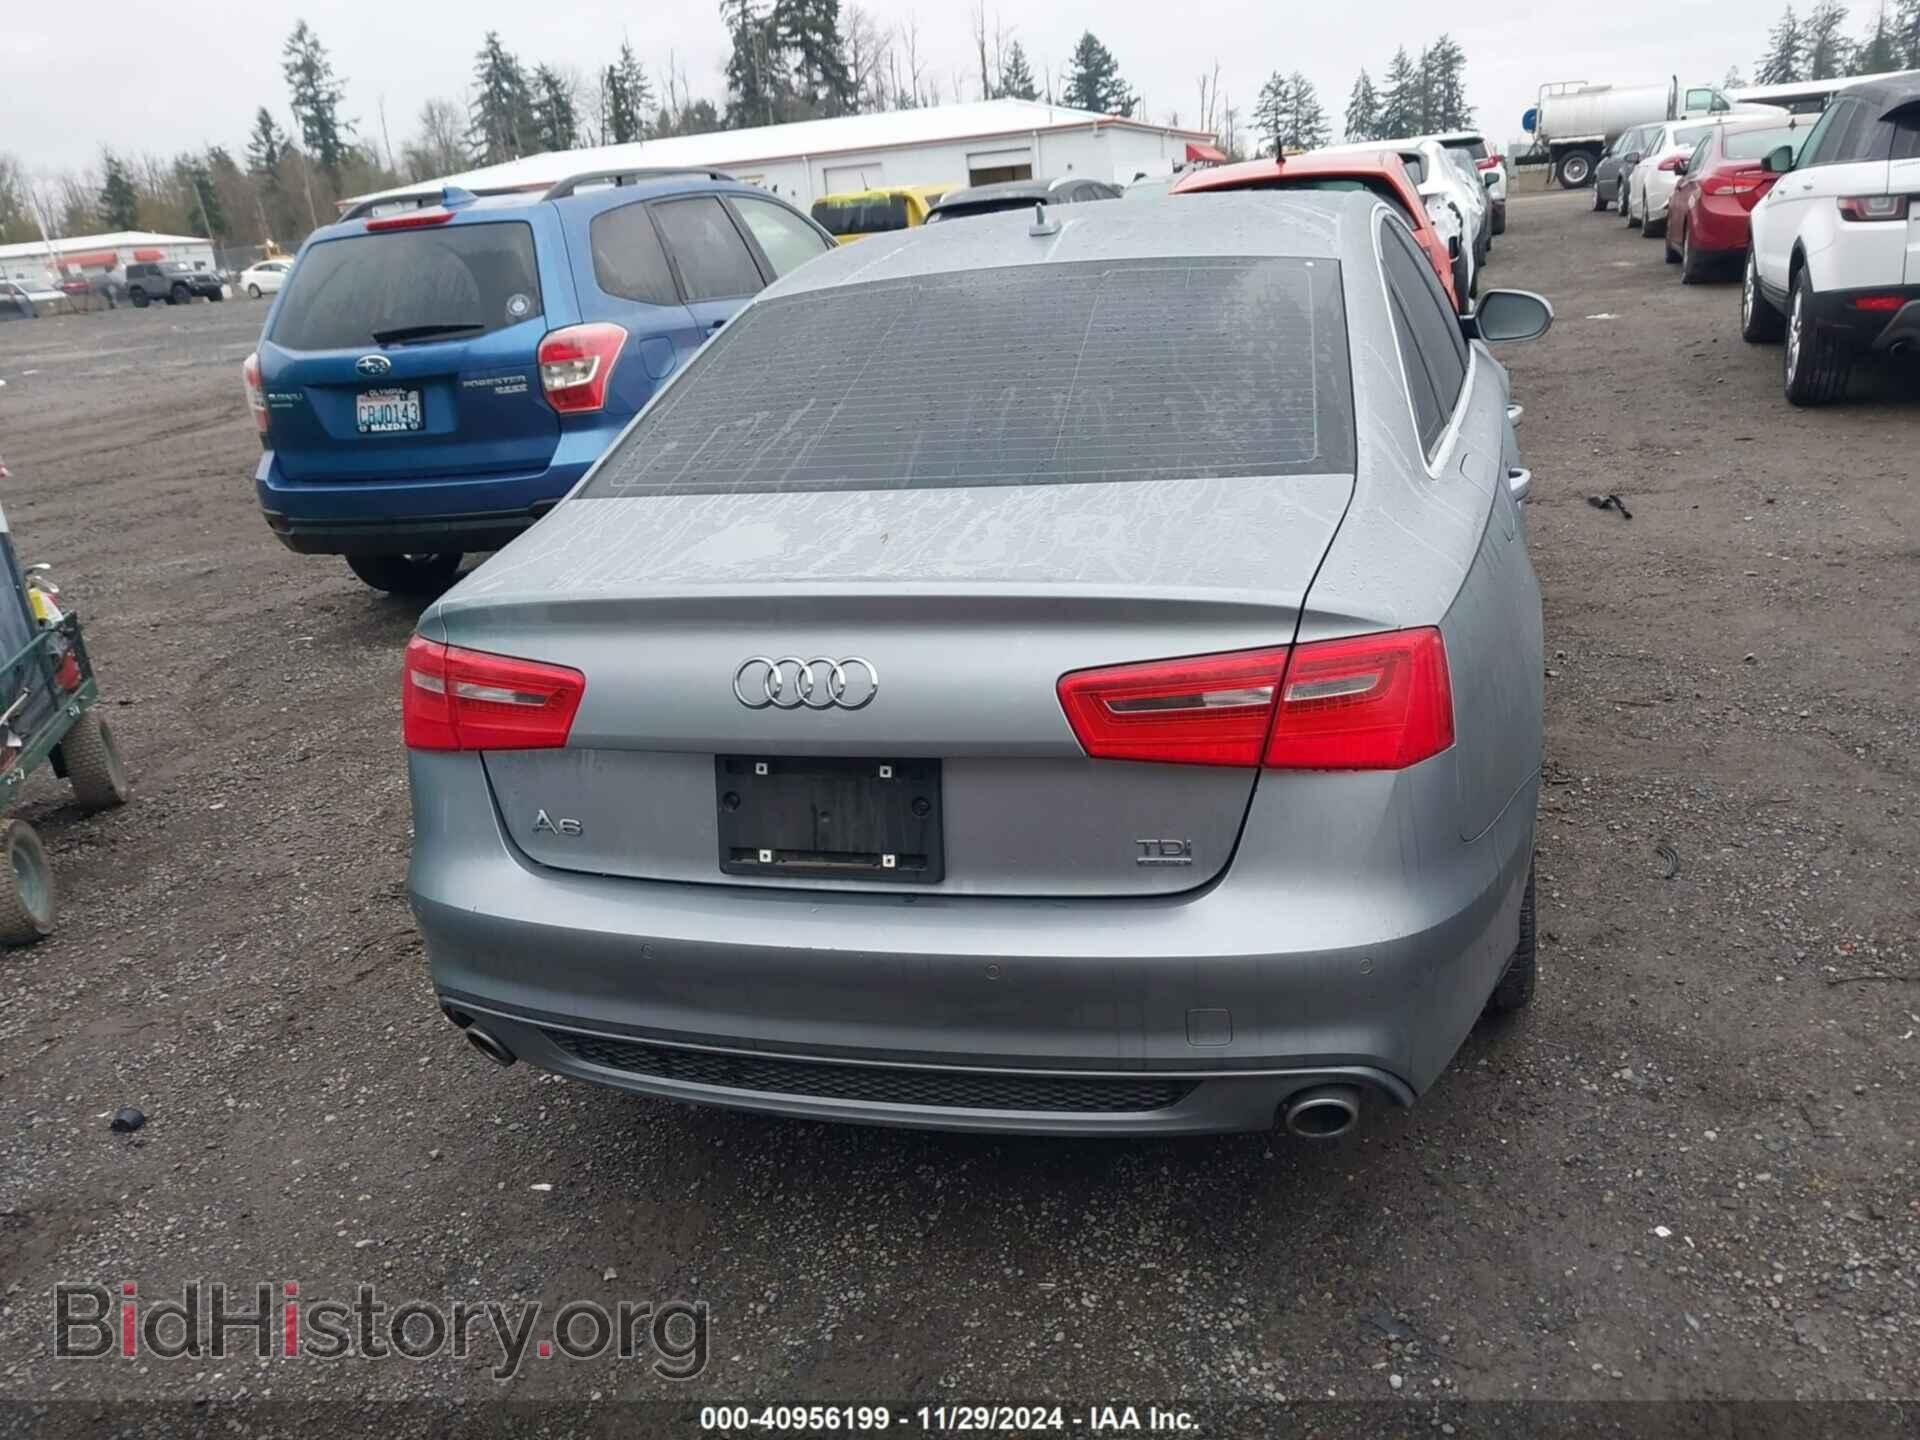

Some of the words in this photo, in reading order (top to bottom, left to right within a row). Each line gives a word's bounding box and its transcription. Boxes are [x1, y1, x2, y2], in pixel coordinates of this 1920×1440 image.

[370, 422, 408, 432] MAZDA
[532, 808, 583, 837] A6
[1136, 839, 1192, 856] TDI
